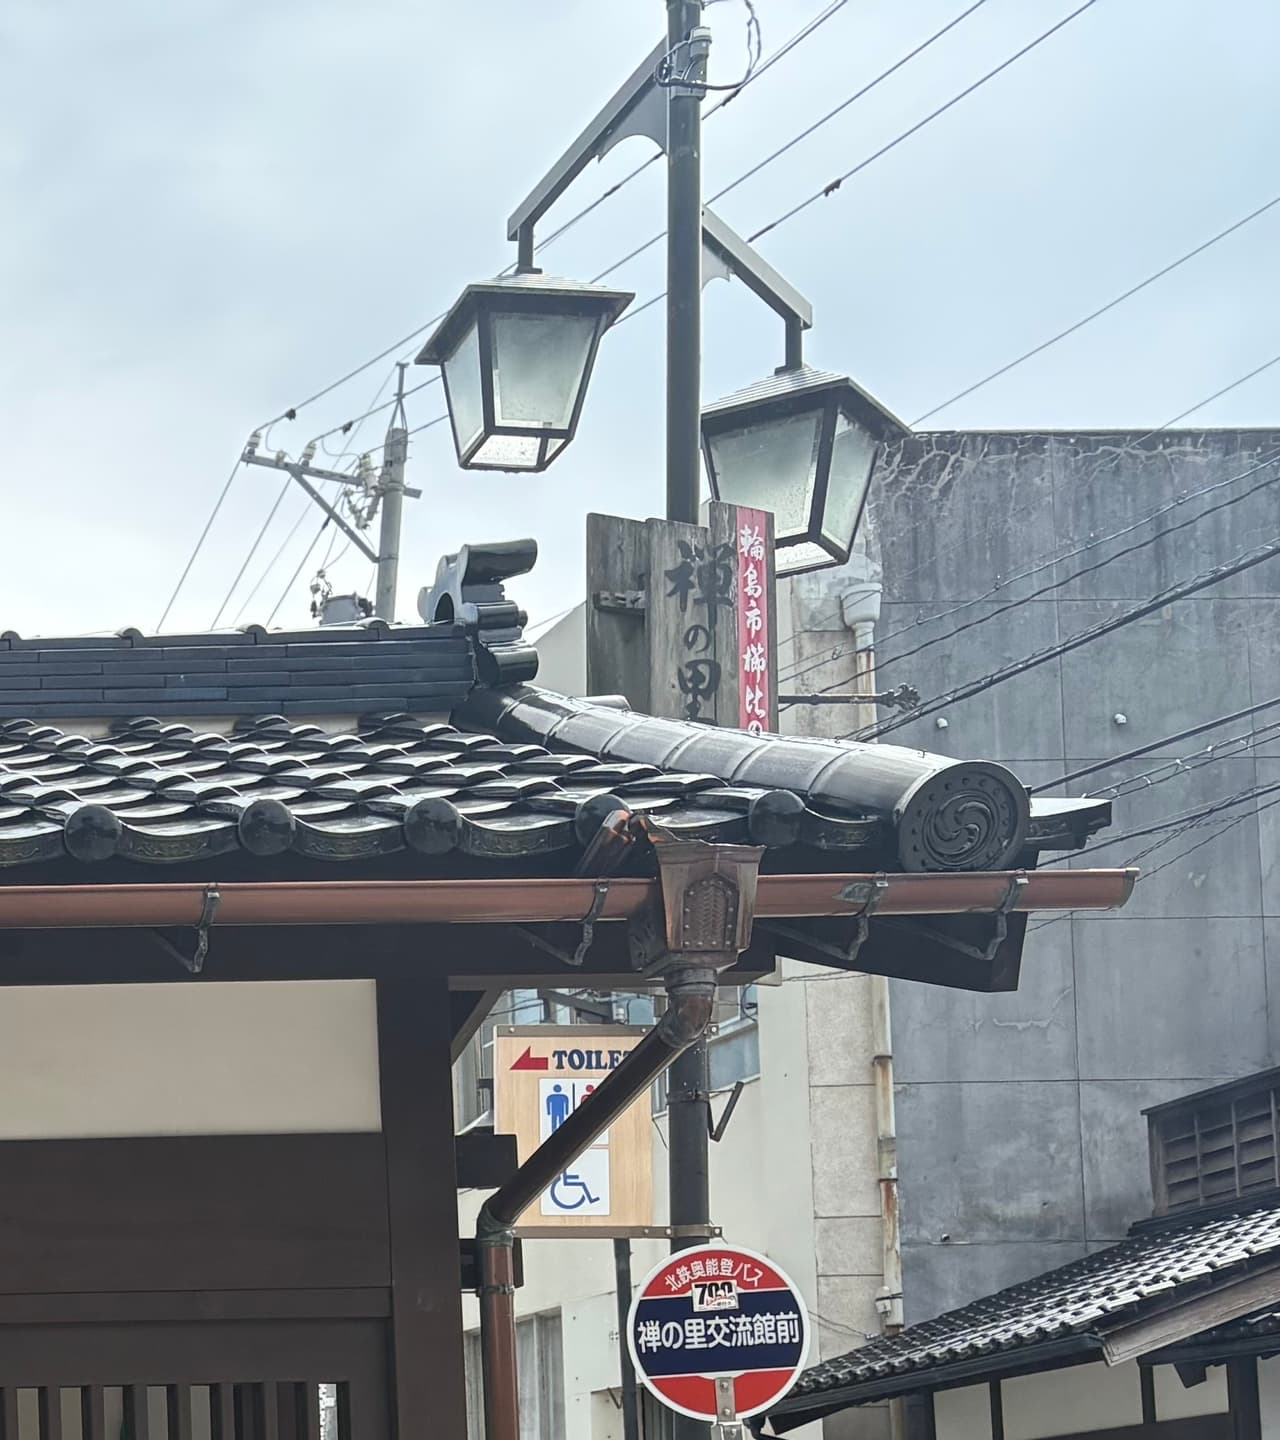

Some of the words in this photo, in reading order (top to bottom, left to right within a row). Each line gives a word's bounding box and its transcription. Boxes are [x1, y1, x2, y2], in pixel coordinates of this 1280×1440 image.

[664, 539, 737, 726] 禅の里
[552, 1049, 632, 1070] TOILE
[665, 1258, 764, 1291] 北鉄奥能登バス
[637, 1311, 800, 1354] 禅の里交流館前
